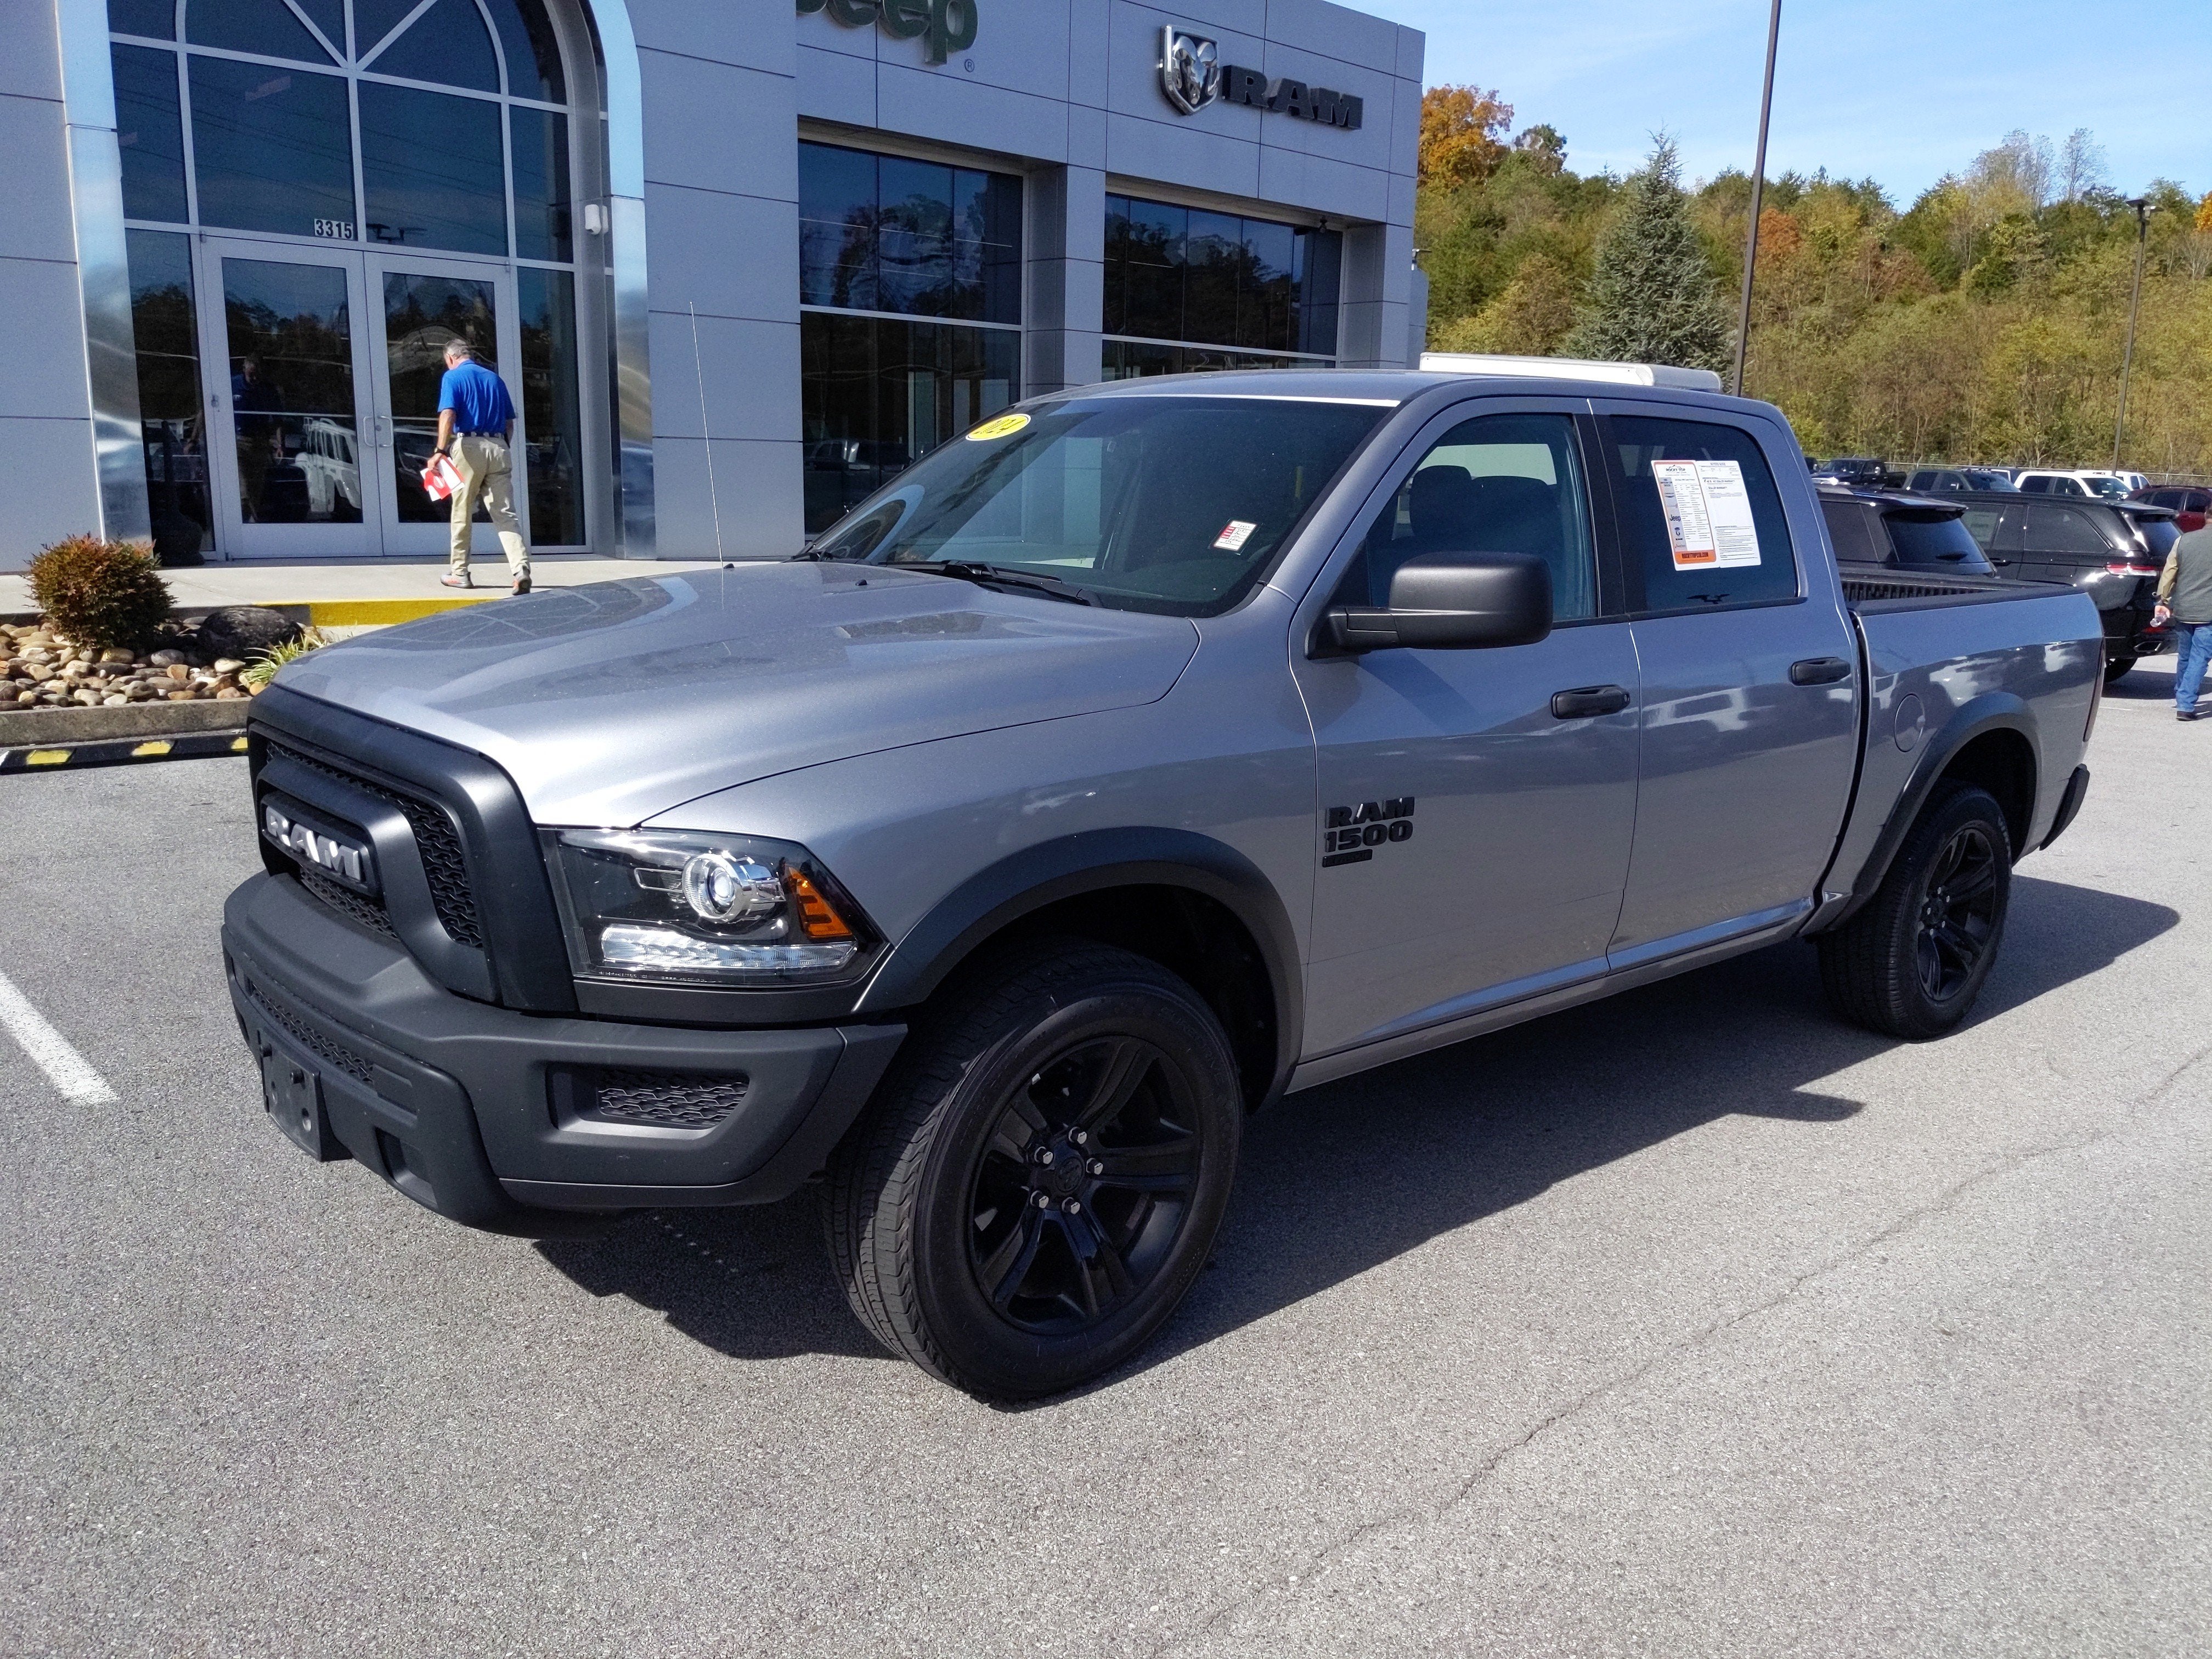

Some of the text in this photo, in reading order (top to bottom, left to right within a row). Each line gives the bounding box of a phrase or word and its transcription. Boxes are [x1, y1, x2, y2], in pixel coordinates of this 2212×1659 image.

[1221, 65, 1363, 130] RAM
[315, 219, 352, 239] 3315
[1669, 514, 1681, 522] Jeep
[1325, 797, 1415, 829] RAM
[266, 805, 362, 882] RAM
[1324, 820, 1413, 853] 1500
